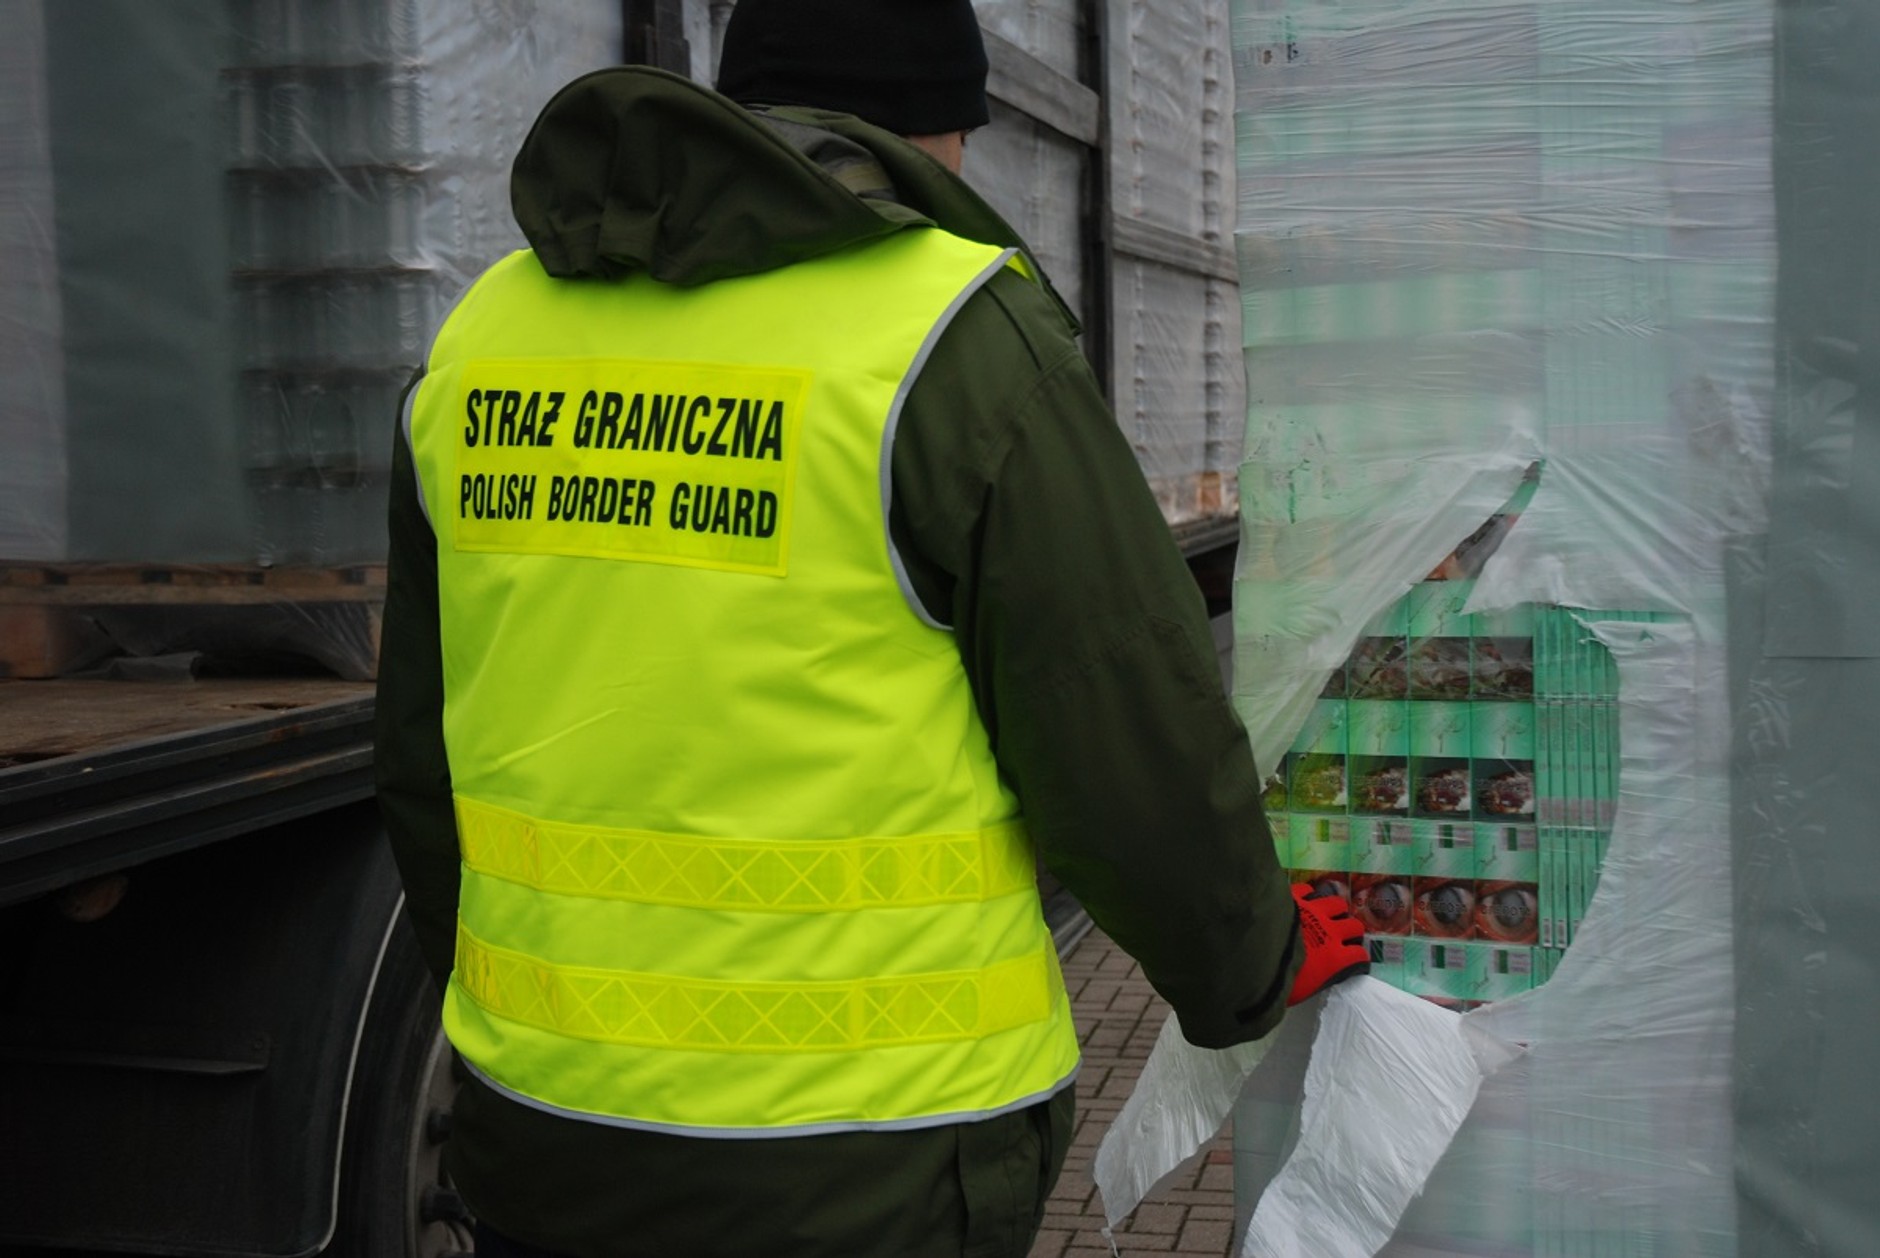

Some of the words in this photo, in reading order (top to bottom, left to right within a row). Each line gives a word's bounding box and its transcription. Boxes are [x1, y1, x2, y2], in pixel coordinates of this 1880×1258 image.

[573, 389, 784, 462] GRANICZNA
[460, 473, 537, 521] POLISH
[546, 475, 656, 527] BORDER
[669, 482, 778, 539] GUARD
